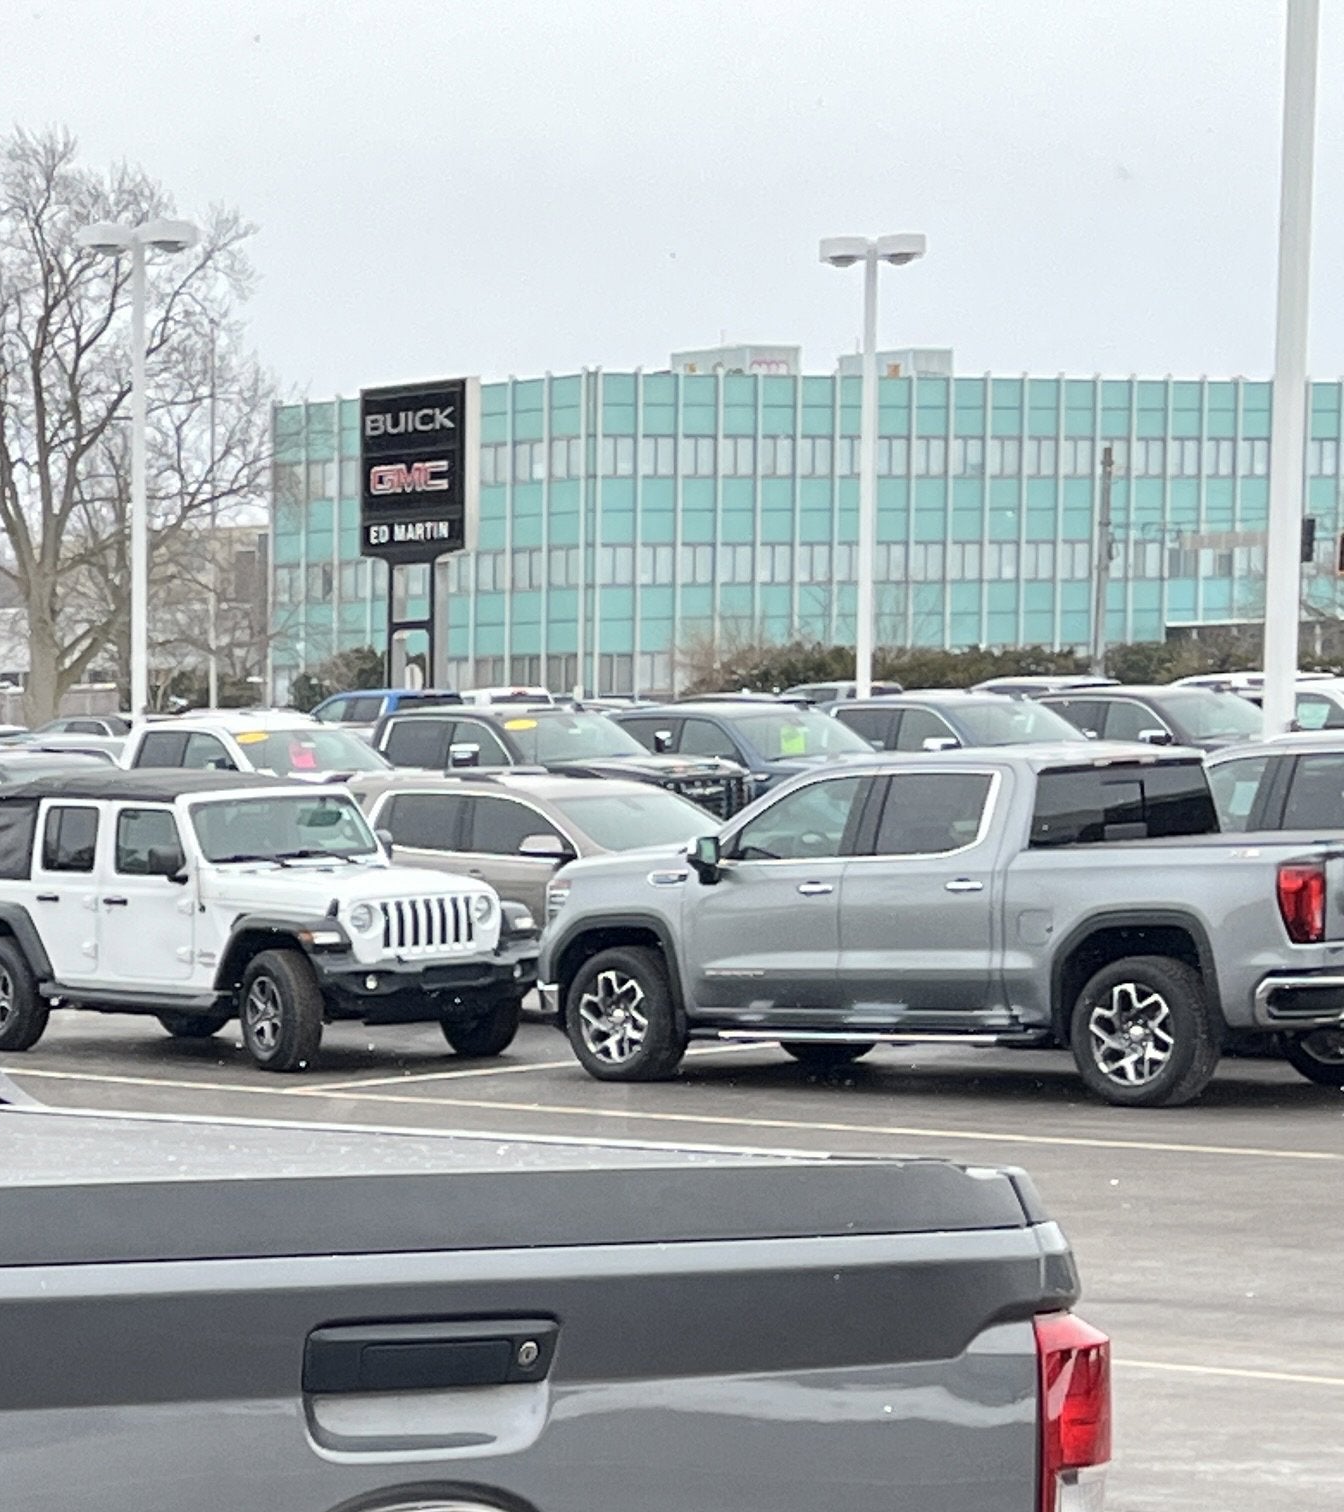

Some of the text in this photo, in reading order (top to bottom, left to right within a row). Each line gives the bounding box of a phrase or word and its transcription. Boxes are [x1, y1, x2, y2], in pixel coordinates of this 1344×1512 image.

[365, 406, 455, 436] BUICK
[370, 460, 449, 494] GMC
[370, 521, 449, 544] ED MARTIN
